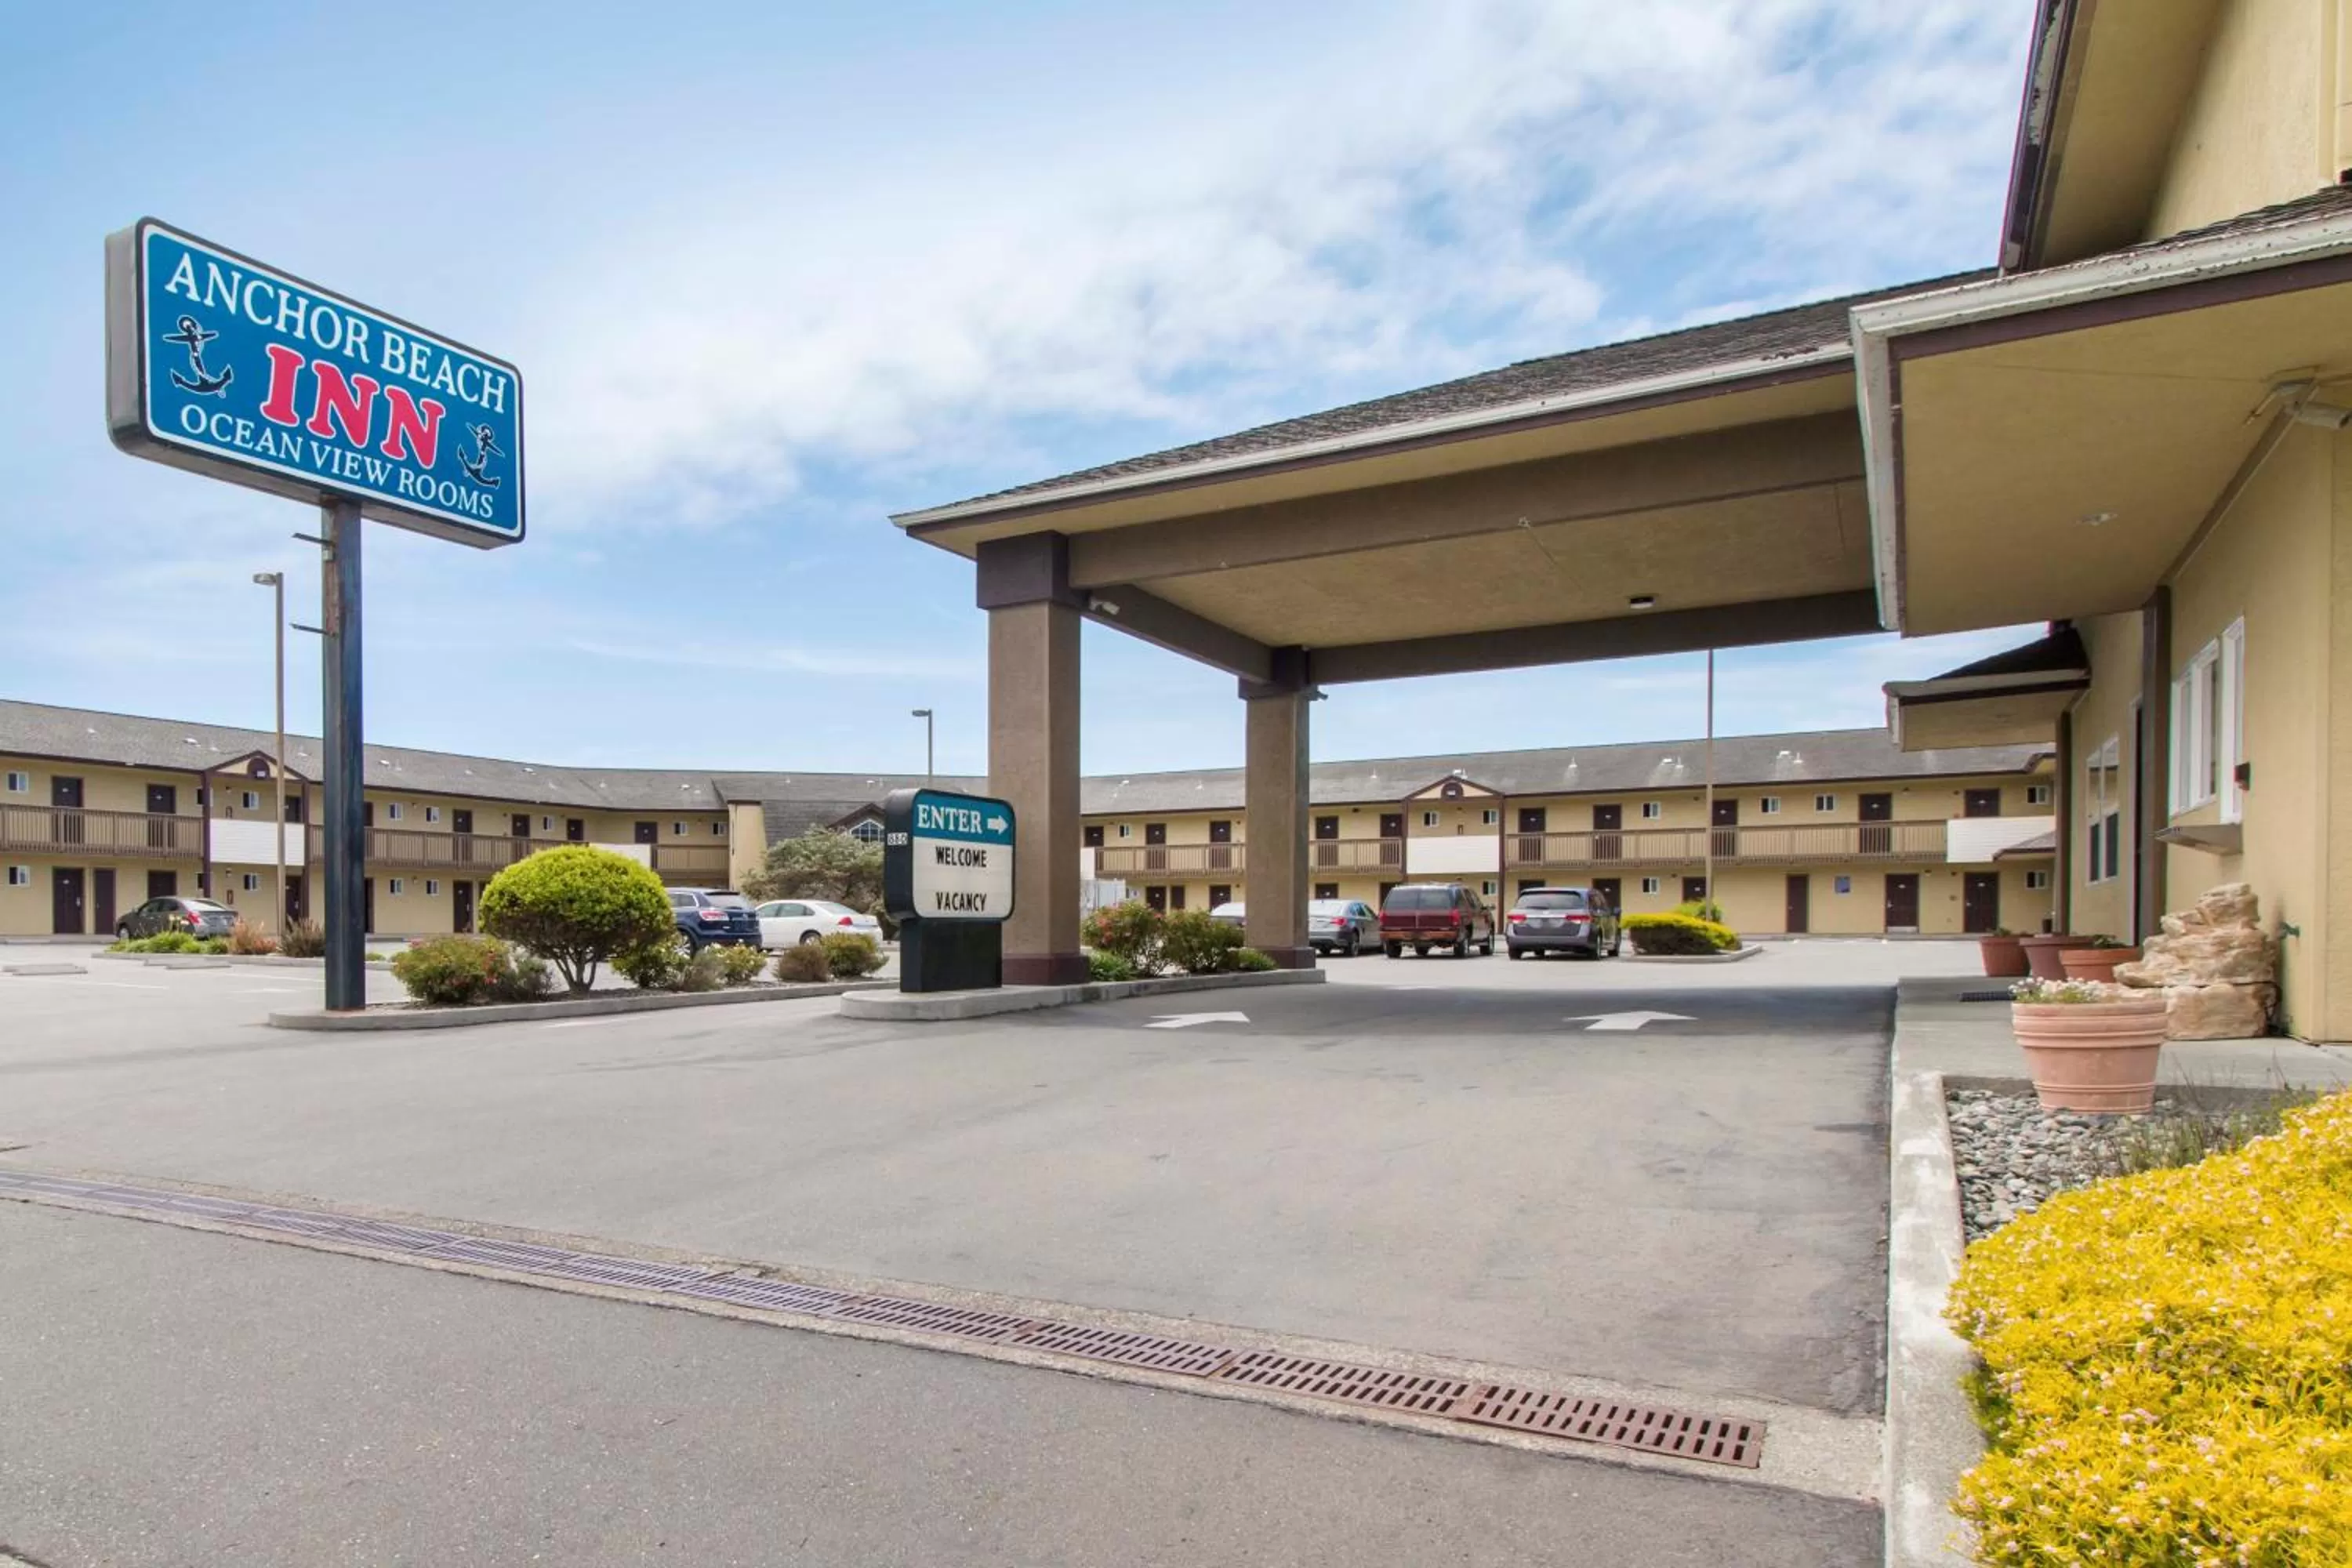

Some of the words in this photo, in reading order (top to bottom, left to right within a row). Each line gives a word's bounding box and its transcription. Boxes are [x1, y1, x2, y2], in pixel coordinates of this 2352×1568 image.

[165, 252, 371, 364] ANCHOR
[381, 329, 507, 413] BEACH
[260, 343, 446, 470] INN
[180, 403, 303, 463] OCEAN
[310, 441, 392, 488] VIEW
[398, 472, 494, 519] ROOMS
[917, 804, 982, 833] ENTER
[935, 845, 987, 868] WELCOME
[935, 891, 987, 912] VACANCY
